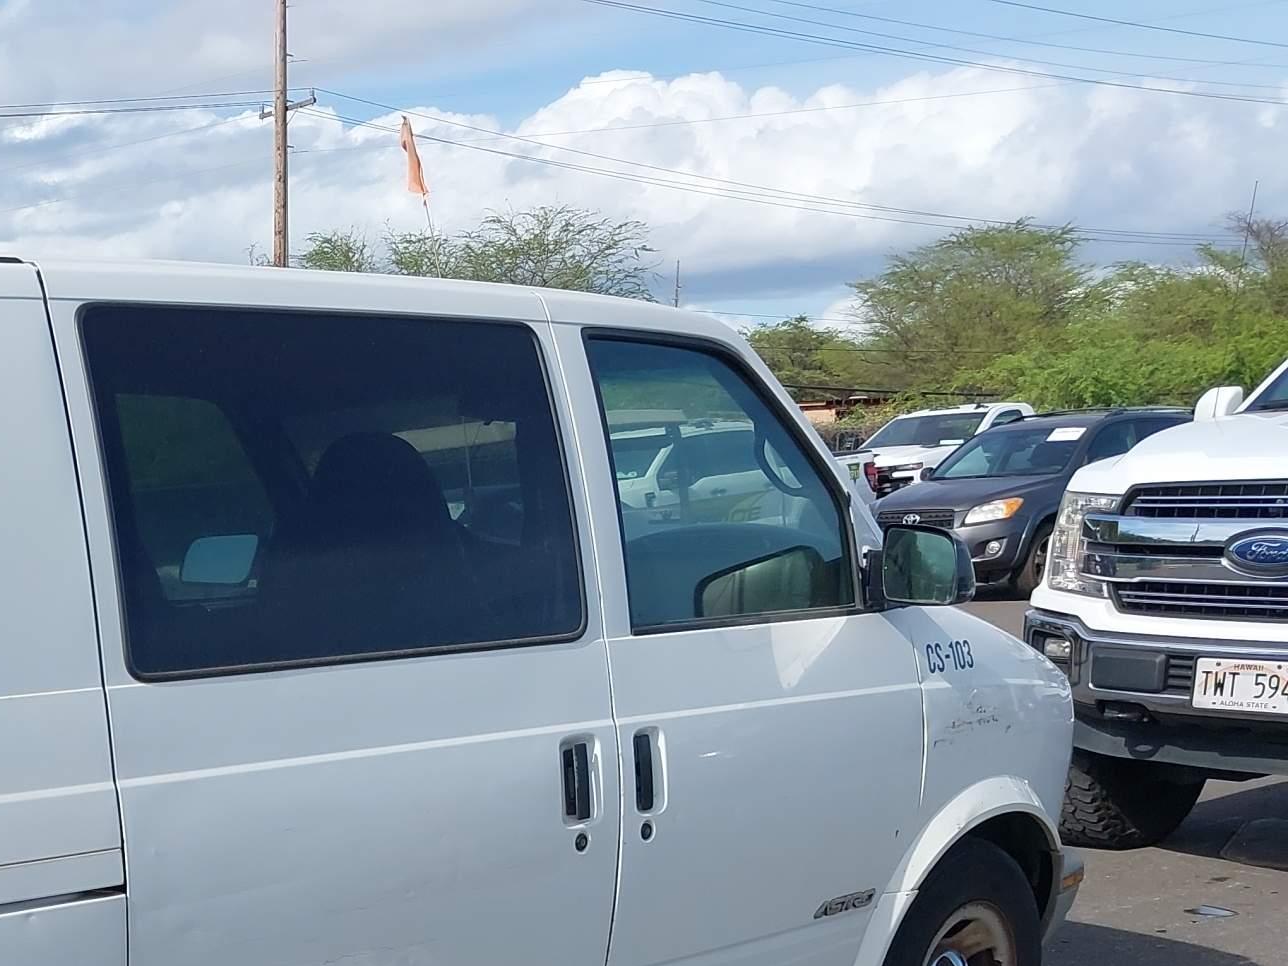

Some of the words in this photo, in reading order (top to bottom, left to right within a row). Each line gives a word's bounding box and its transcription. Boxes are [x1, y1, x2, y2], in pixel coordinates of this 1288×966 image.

[926, 639, 974, 674] CS-103
[1201, 671, 1240, 697] TWT
[1219, 700, 1244, 708] ALOHA
[814, 888, 876, 919] ASTRO
